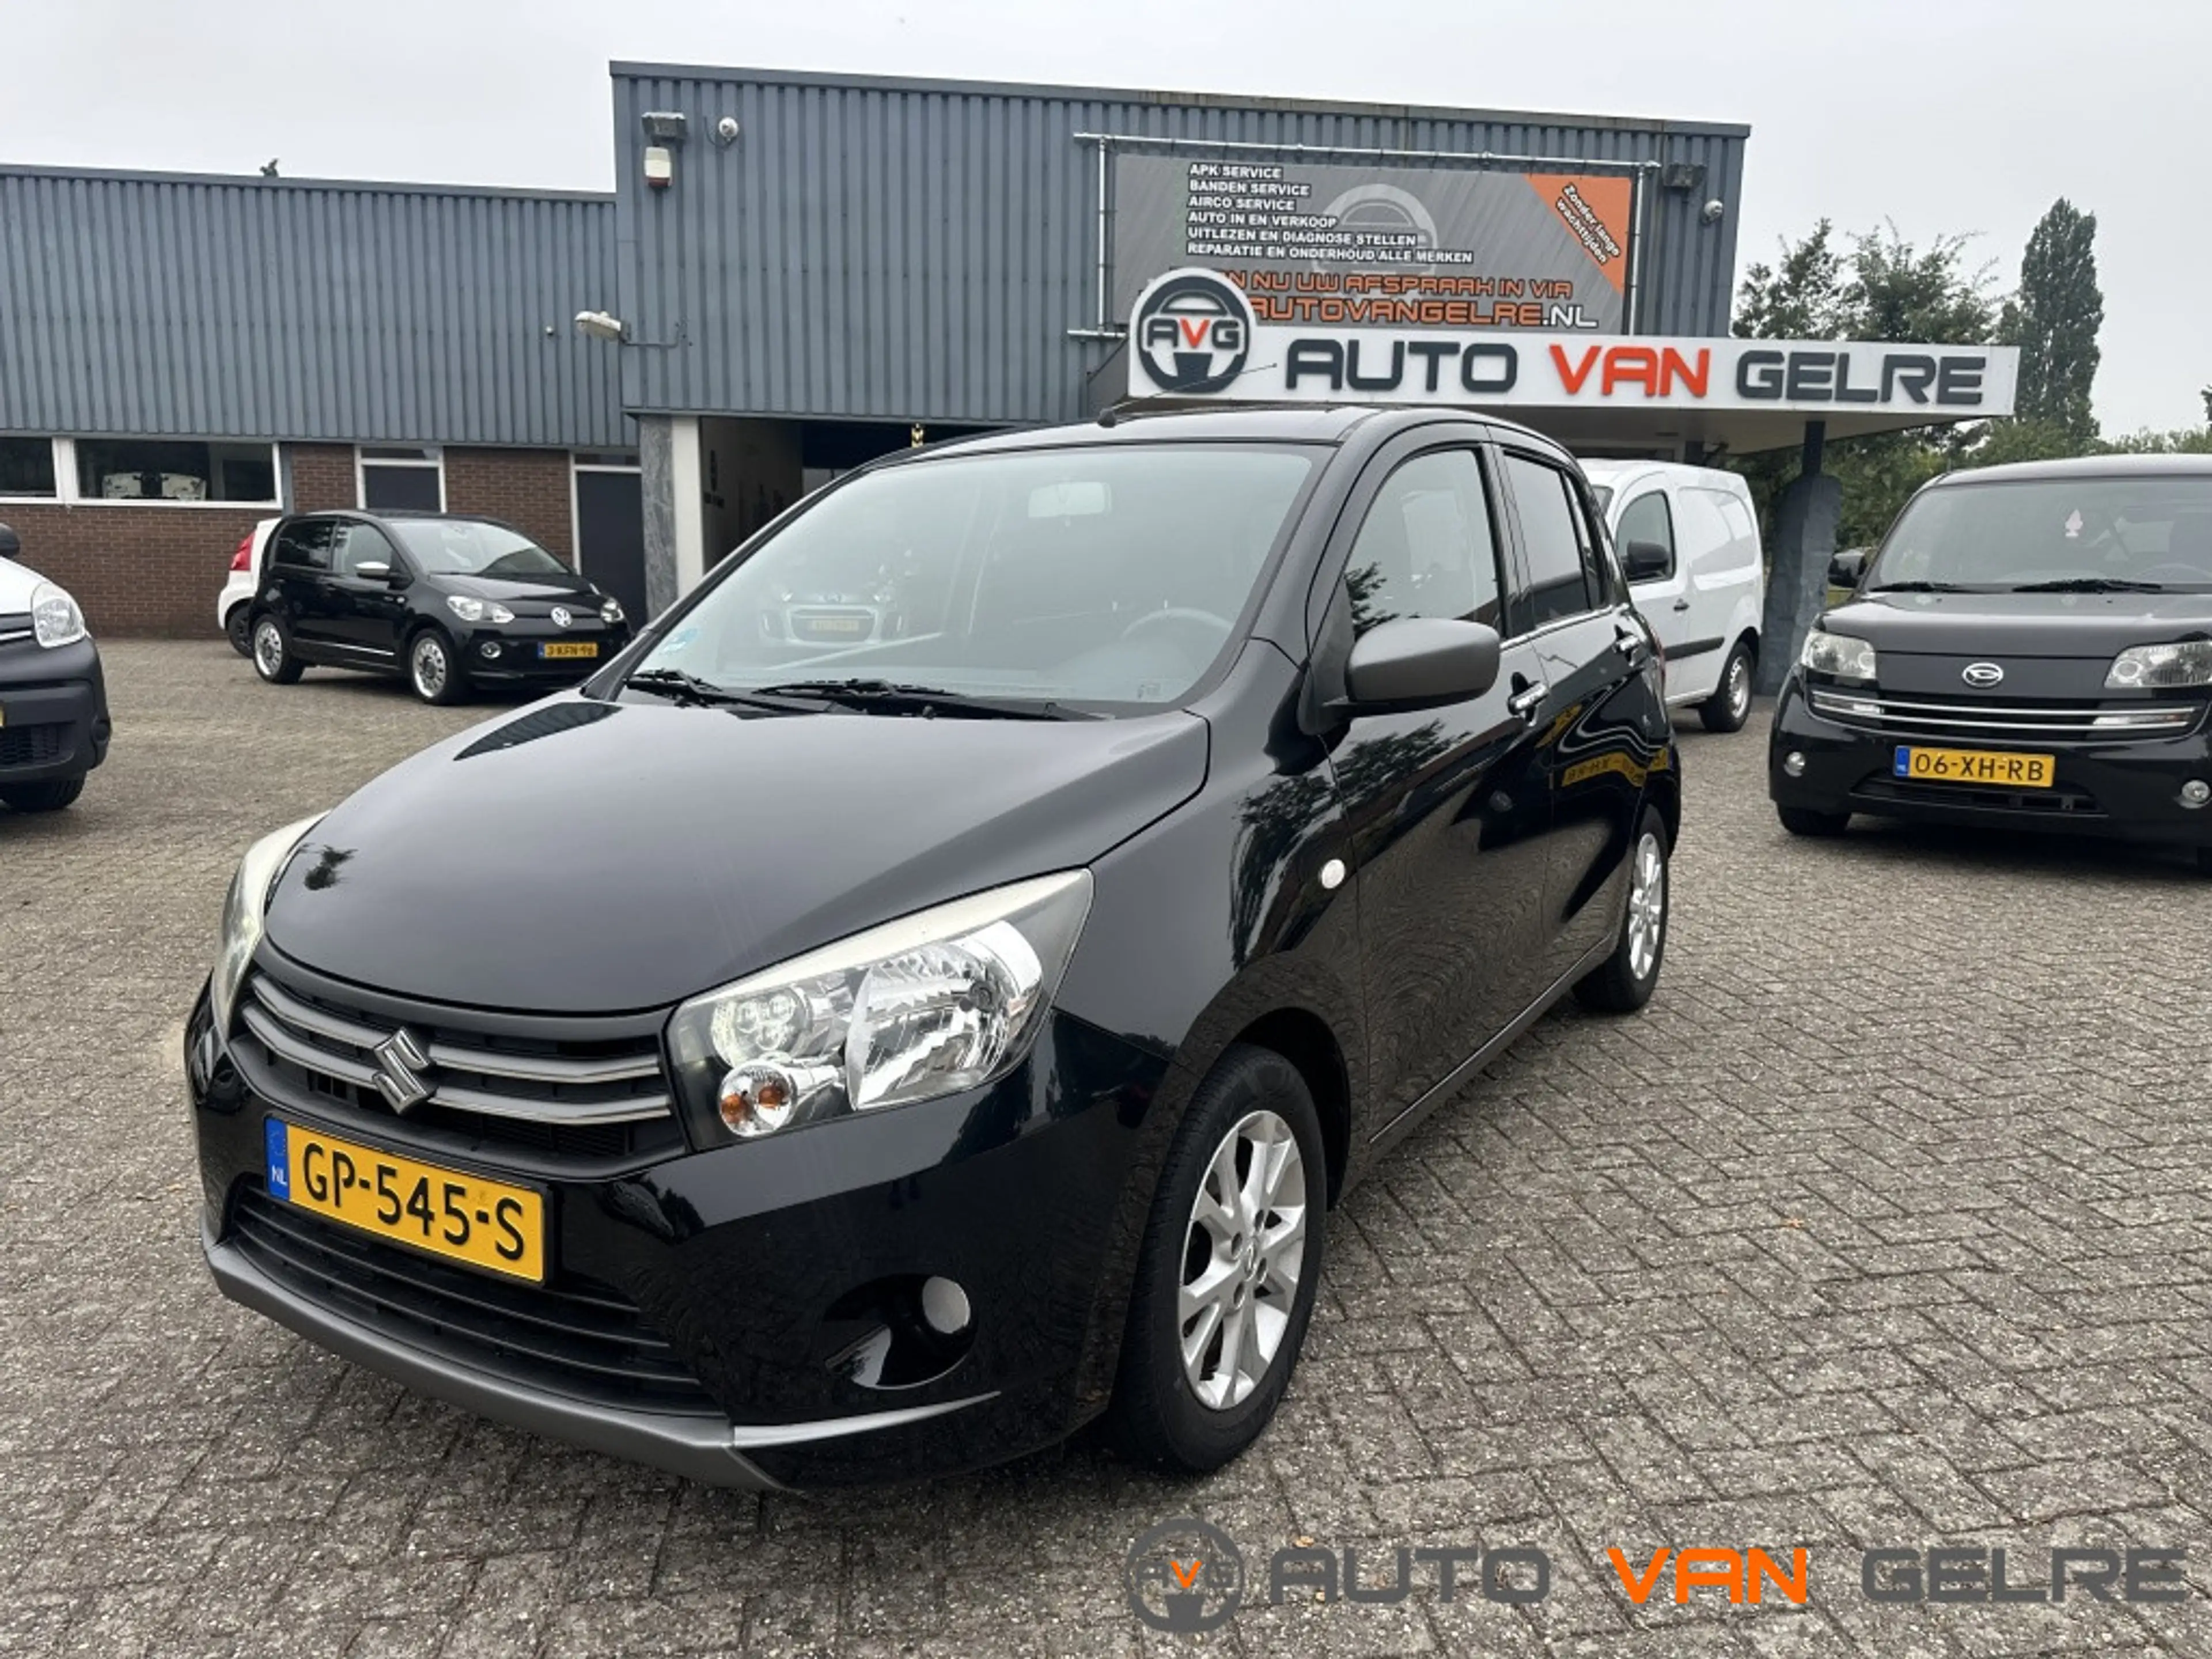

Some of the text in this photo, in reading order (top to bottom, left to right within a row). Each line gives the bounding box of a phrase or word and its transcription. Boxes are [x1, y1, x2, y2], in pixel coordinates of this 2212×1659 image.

[1189, 164, 1282, 179] APK SERVICE
[1189, 180, 1310, 196] BANDEN SERVICE
[1188, 196, 1296, 211] AIRCO SERVICE
[1188, 211, 1338, 228] AUTO IN EN VERKOOP
[1557, 198, 1607, 263] wachttijden
[1563, 184, 1620, 256] Zonder lange
[1187, 226, 1416, 246] UITLEZEN EN DIAGNOSE STELLEN
[1187, 242, 1473, 263] REPARATIE EN ONDERHOUD ALLE MERKEN
[1252, 272, 1291, 291] NU
[1296, 273, 1339, 293] UW
[1343, 275, 1494, 296] AFSPRAAK
[1500, 279, 1524, 297] IN
[1529, 281, 1573, 298] VIA
[1146, 317, 1241, 350] AVG
[1285, 338, 1987, 406] AUTO VAN GELRE
[1915, 753, 2044, 781] 06-XH-RB
[271, 1165, 287, 1186] NL
[302, 1141, 525, 1261] GP-545-S
